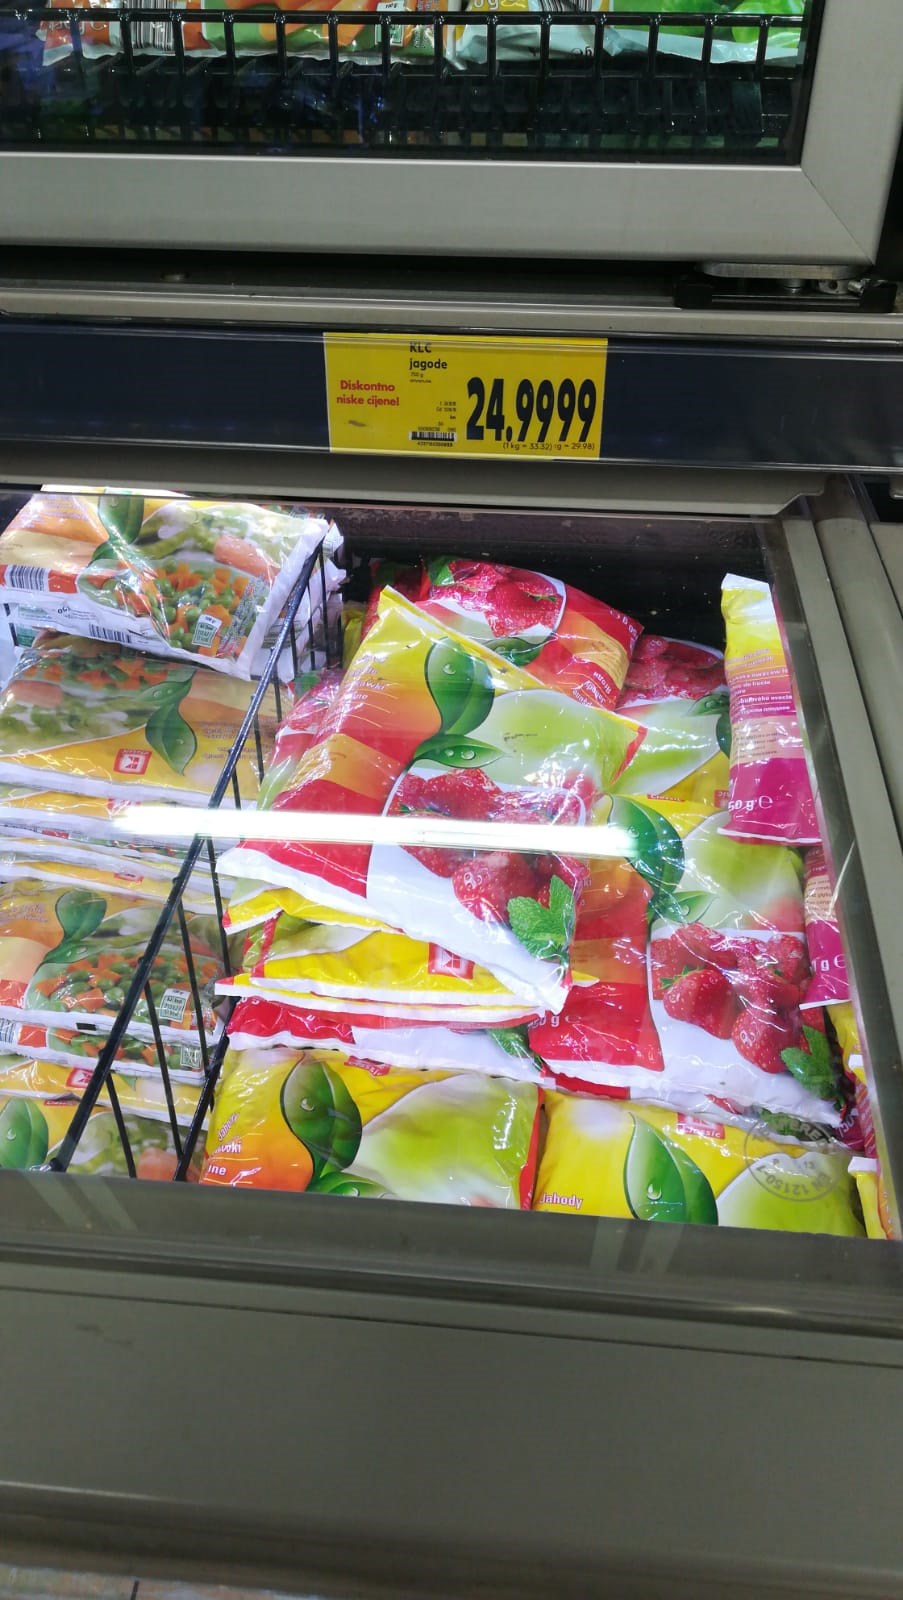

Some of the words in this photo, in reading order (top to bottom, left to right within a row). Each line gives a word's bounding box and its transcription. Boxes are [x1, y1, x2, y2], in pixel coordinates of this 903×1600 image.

[410, 342, 432, 353] KLC
[409, 358, 448, 370] jagode
[340, 380, 395, 391] Diskontno
[336, 394, 364, 405] niske
[367, 395, 400, 408] cijene!
[540, 1191, 584, 1210] Jahody
